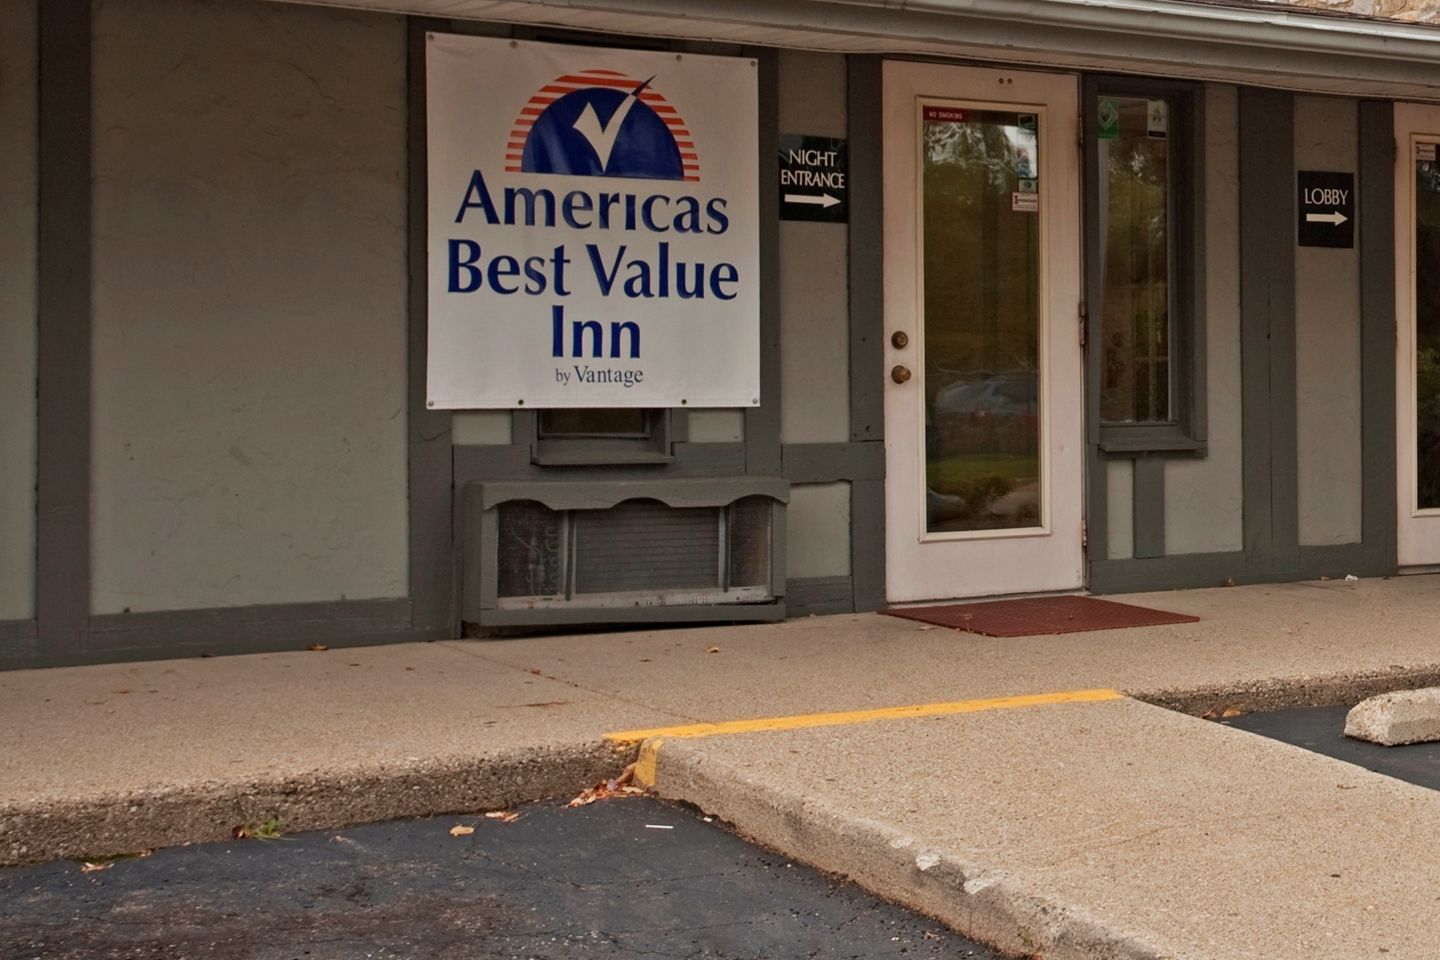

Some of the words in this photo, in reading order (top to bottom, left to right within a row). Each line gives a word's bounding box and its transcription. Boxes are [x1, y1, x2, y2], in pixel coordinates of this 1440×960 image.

[789, 149, 838, 167] NIGHT
[781, 169, 846, 189] ENTRANCE
[454, 169, 730, 235] Americas
[1304, 187, 1349, 206] LOBBY
[447, 238, 572, 297] Best
[585, 242, 740, 301] Value
[551, 305, 641, 360] Inn
[555, 367, 571, 386] by
[574, 365, 644, 388] Vantage
